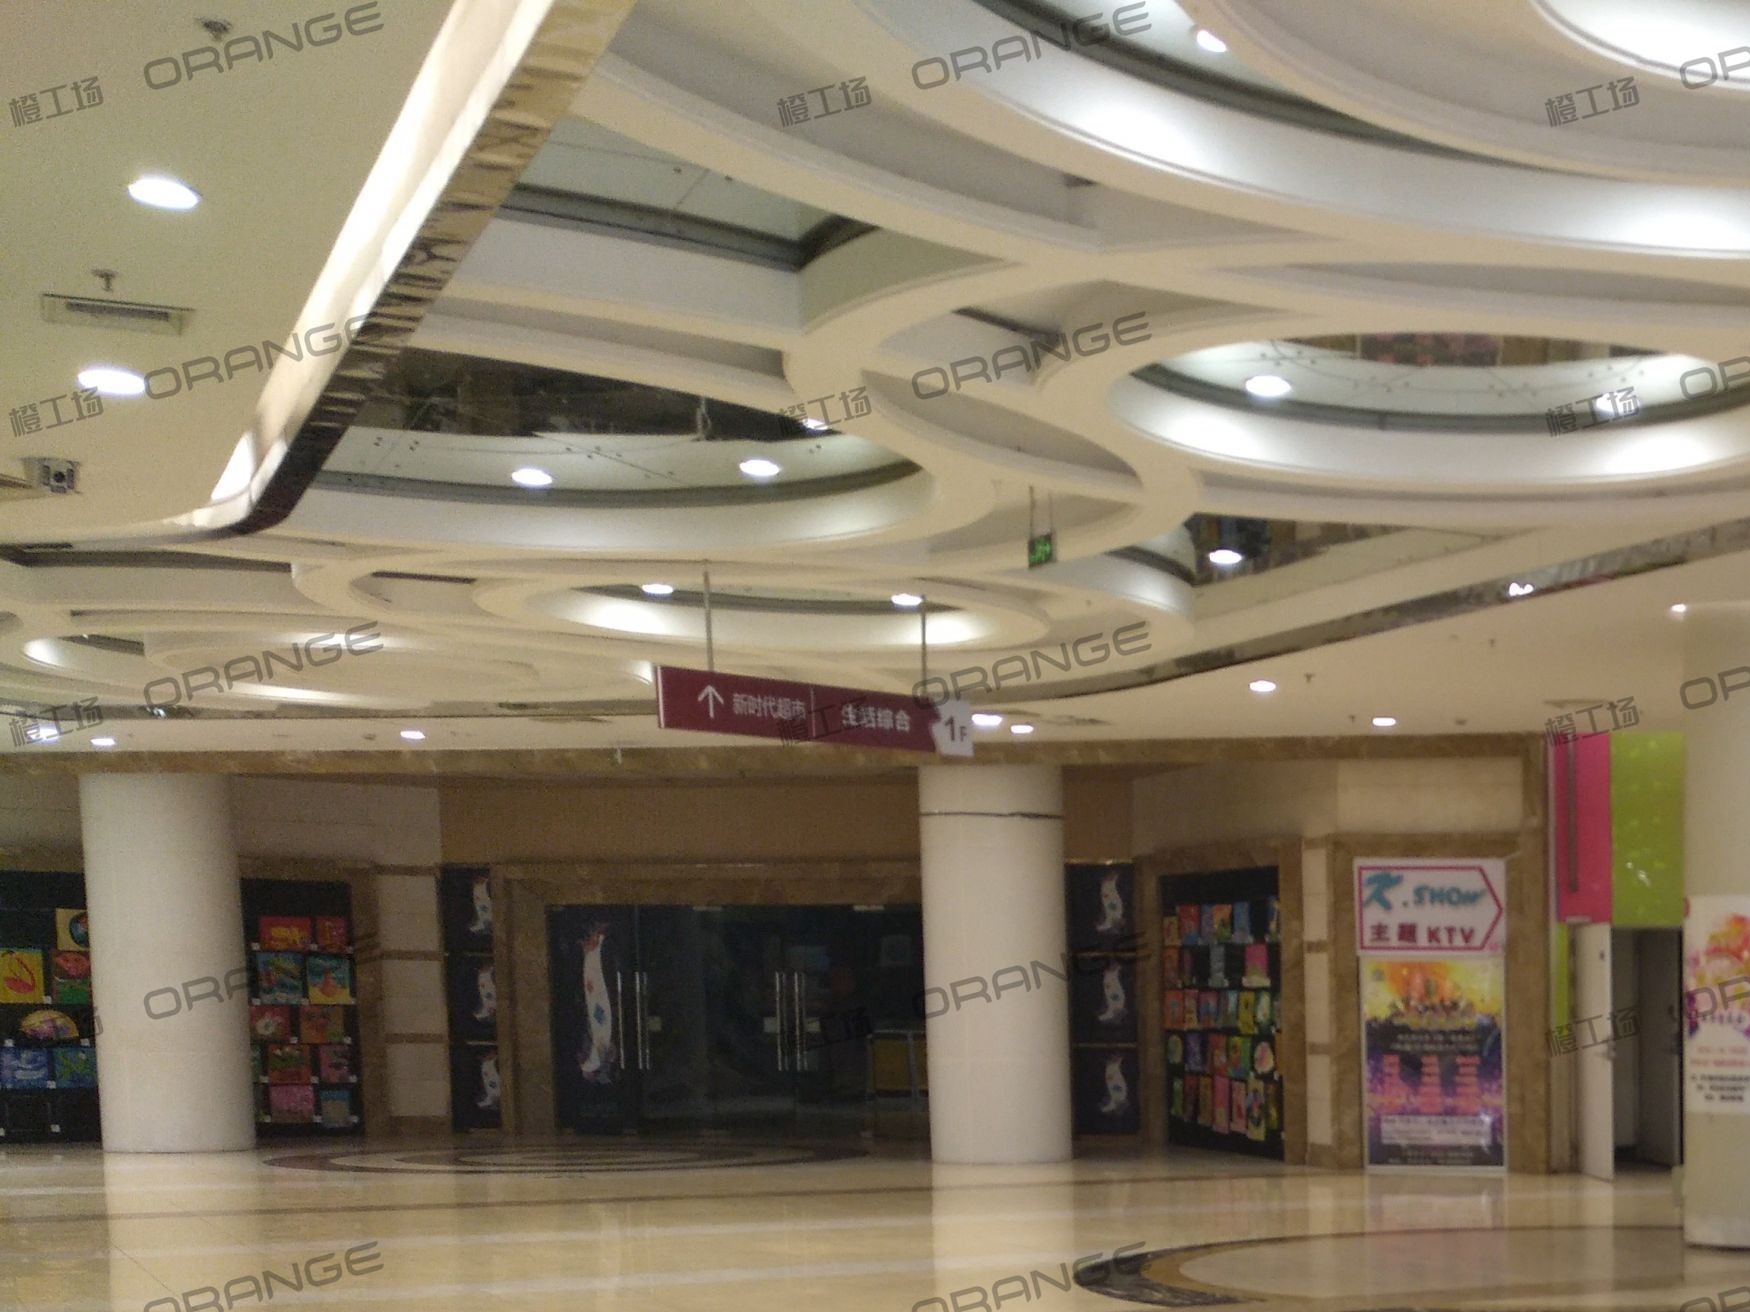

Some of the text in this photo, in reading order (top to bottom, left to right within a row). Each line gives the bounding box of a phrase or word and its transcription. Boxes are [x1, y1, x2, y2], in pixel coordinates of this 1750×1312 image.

[732, 692, 806, 723] 新时代超市
[943, 714, 969, 744] 1F
